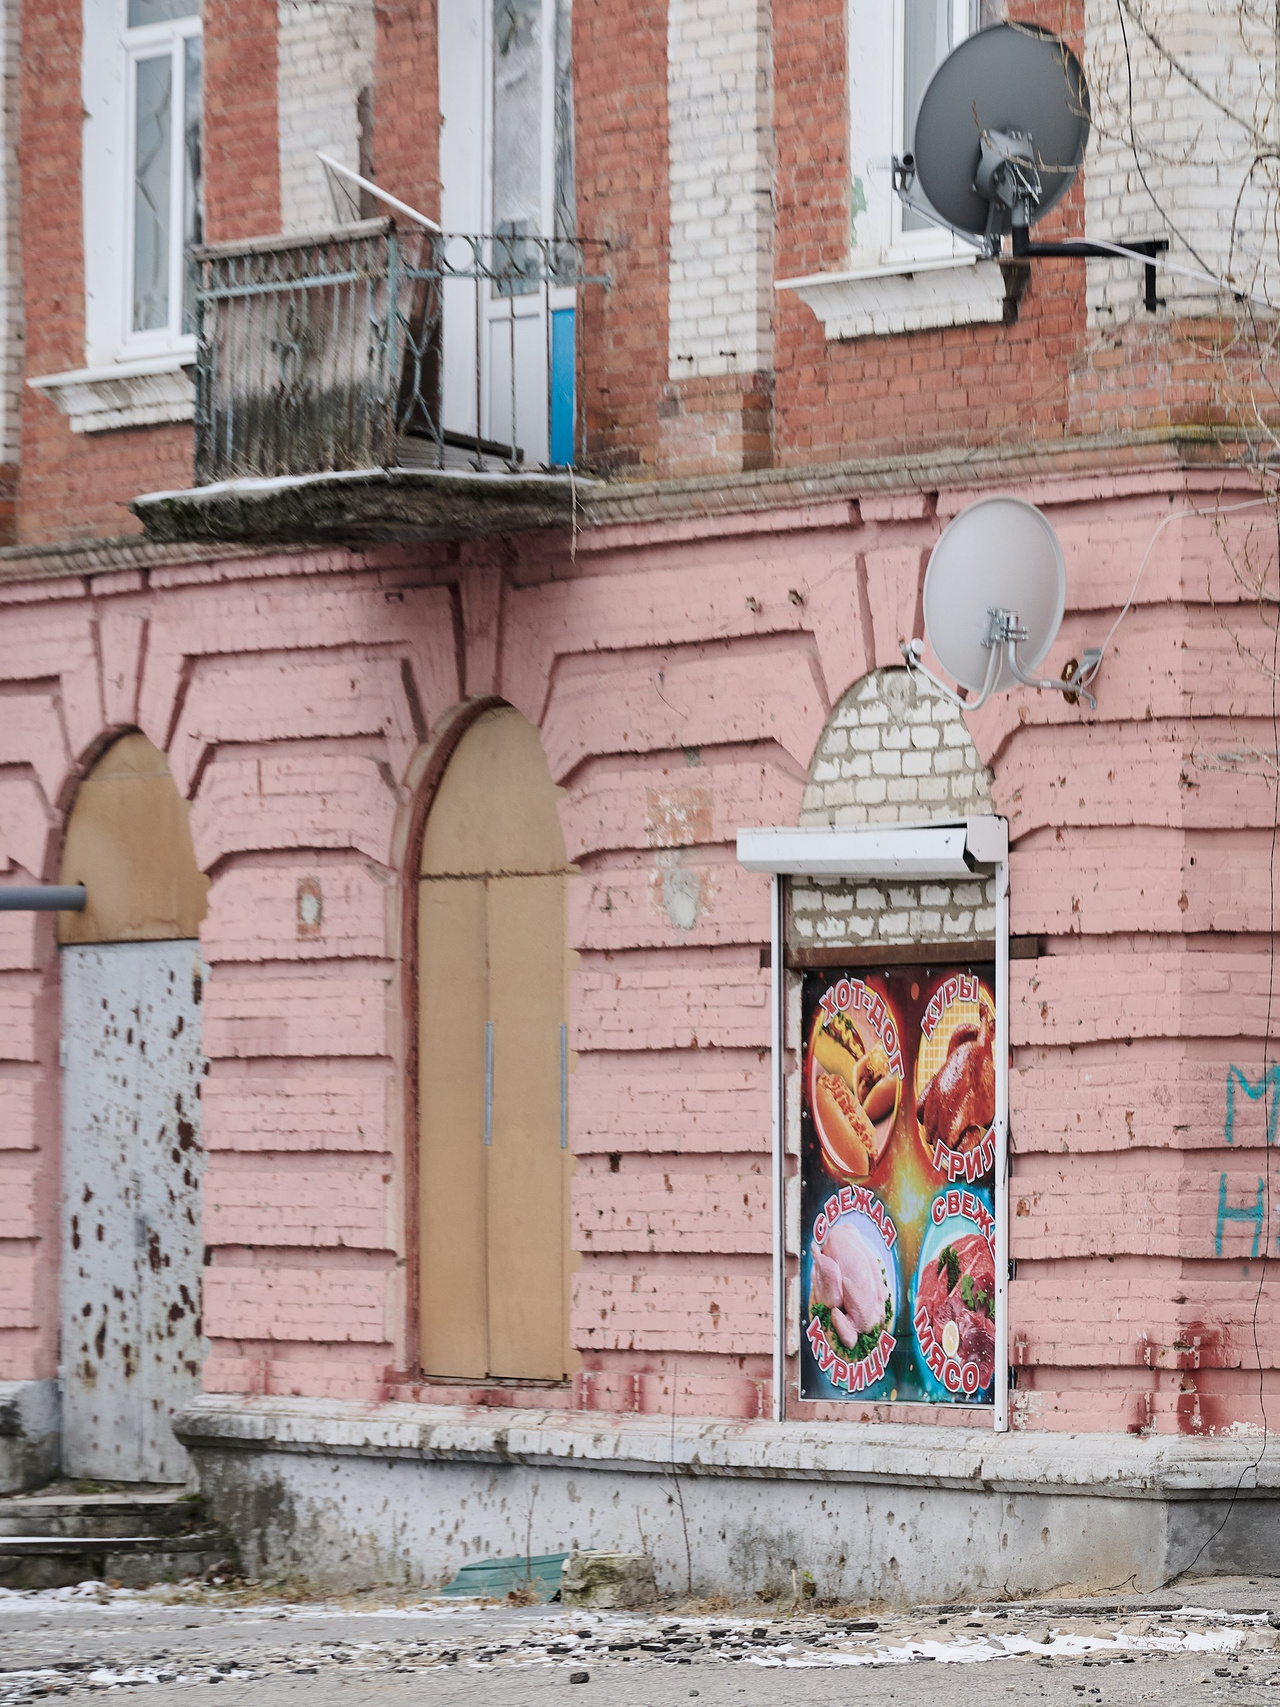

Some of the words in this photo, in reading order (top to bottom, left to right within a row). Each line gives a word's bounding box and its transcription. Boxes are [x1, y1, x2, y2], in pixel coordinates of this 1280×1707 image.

[819, 977, 904, 1080] ХОТ-ДОГ
[921, 973, 979, 1041] КУРЫ
[933, 1115, 996, 1183] ГРИЛ
[813, 1184, 897, 1250] СВЕЖАЯ
[806, 1316, 897, 1393] КУРИЦА
[912, 1306, 980, 1394] МЯСО
